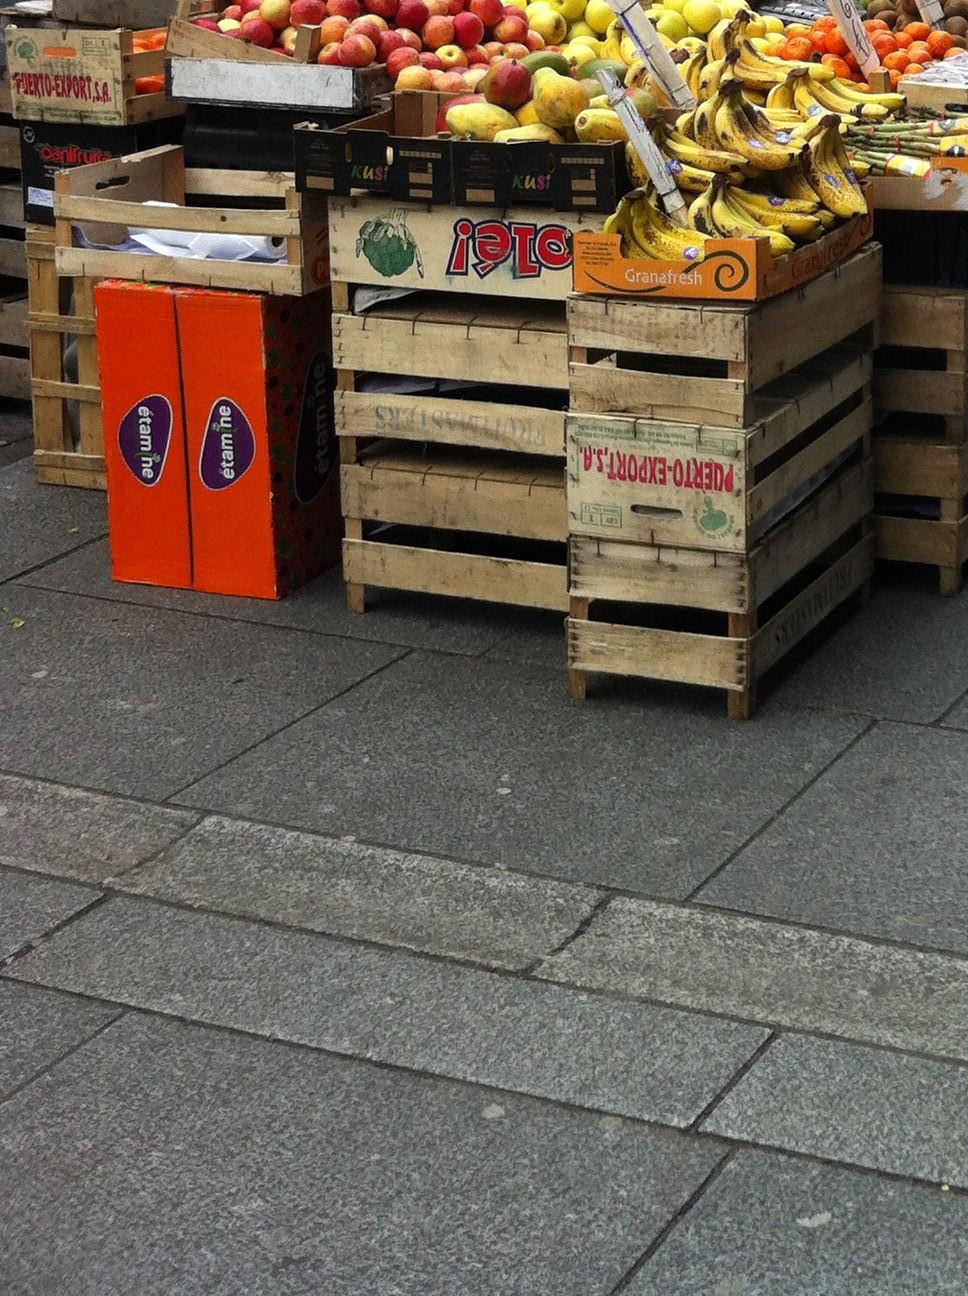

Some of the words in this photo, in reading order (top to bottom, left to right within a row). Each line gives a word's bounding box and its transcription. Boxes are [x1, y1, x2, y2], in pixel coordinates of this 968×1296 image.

[624, 267, 703, 287] Granafresh
[137, 405, 157, 480] étamine
[218, 404, 236, 481] étamine
